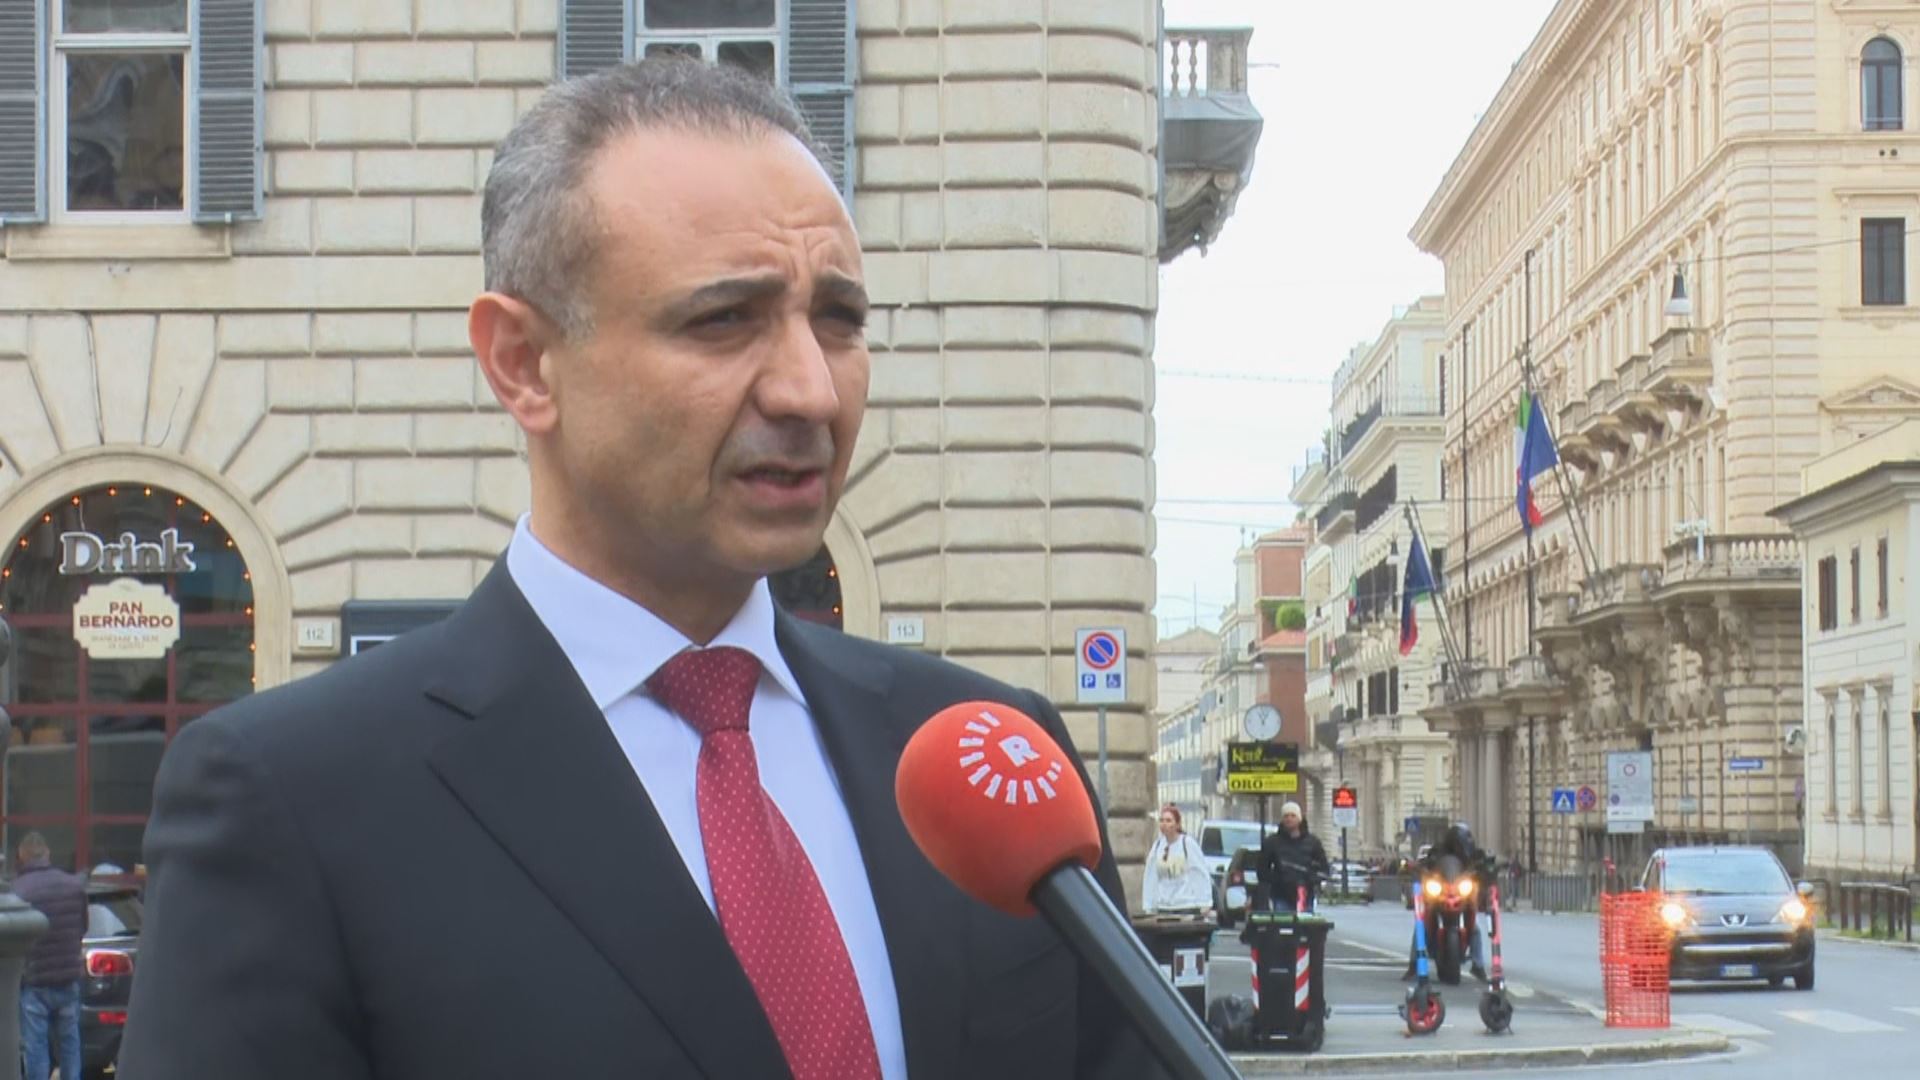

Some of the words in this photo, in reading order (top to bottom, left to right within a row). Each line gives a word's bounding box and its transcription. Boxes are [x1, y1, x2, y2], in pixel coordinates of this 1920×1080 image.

[59, 528, 196, 574] Drink
[109, 602, 143, 614] PAN
[79, 615, 174, 627] BERNARDO
[998, 735, 1040, 768] R
[1231, 779, 1263, 789] ORO
